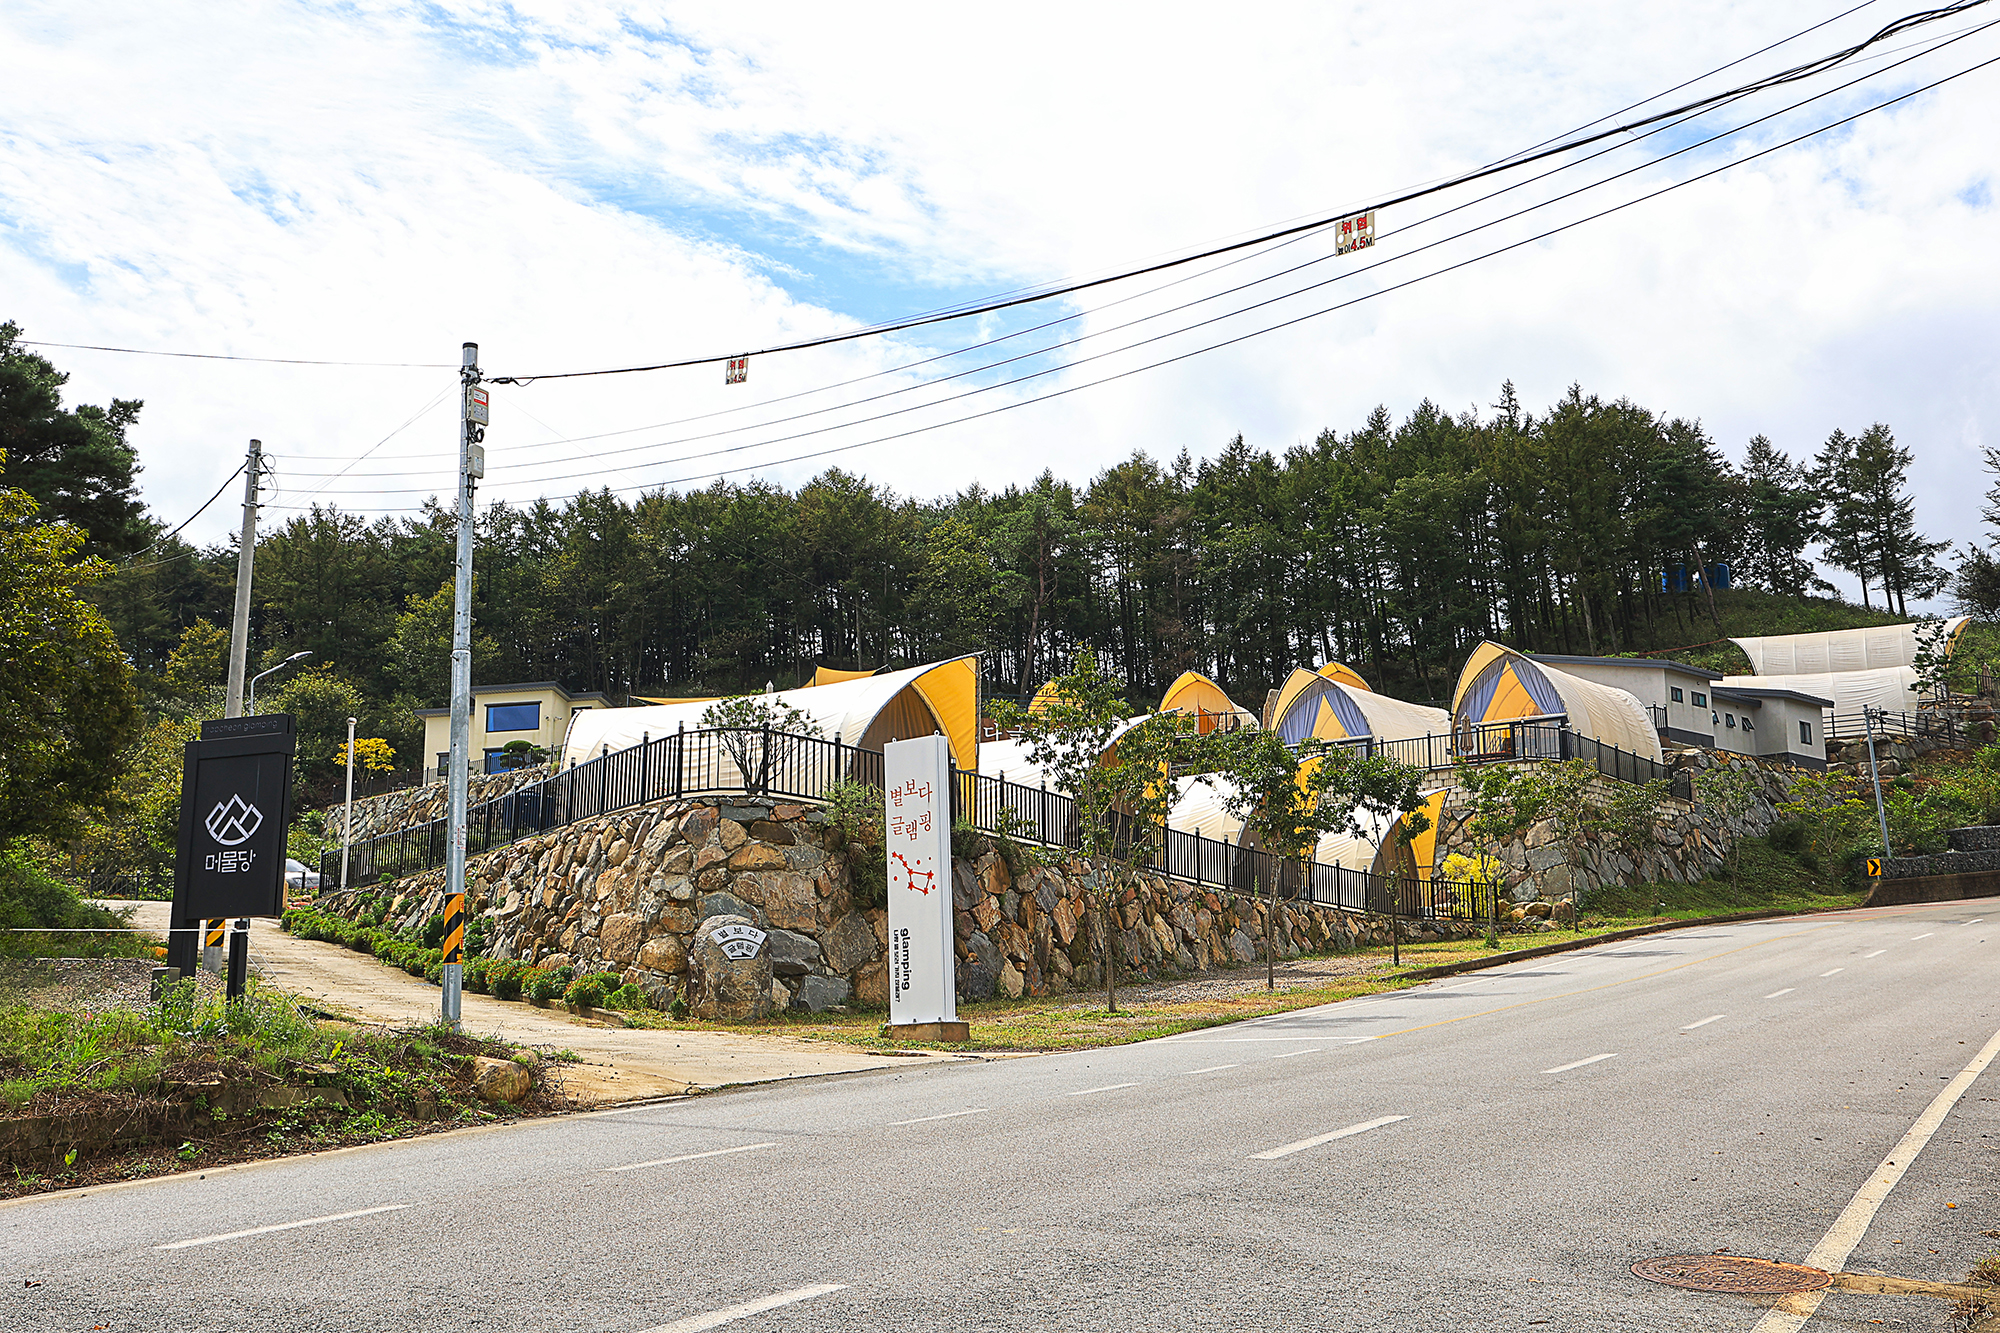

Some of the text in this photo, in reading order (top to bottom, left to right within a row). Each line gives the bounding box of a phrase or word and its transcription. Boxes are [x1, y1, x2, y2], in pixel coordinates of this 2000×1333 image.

[890, 779, 933, 807] 별보다
[891, 811, 931, 841] 글램핑
[205, 849, 256, 873] 머물당
[900, 928, 912, 991] glamping
